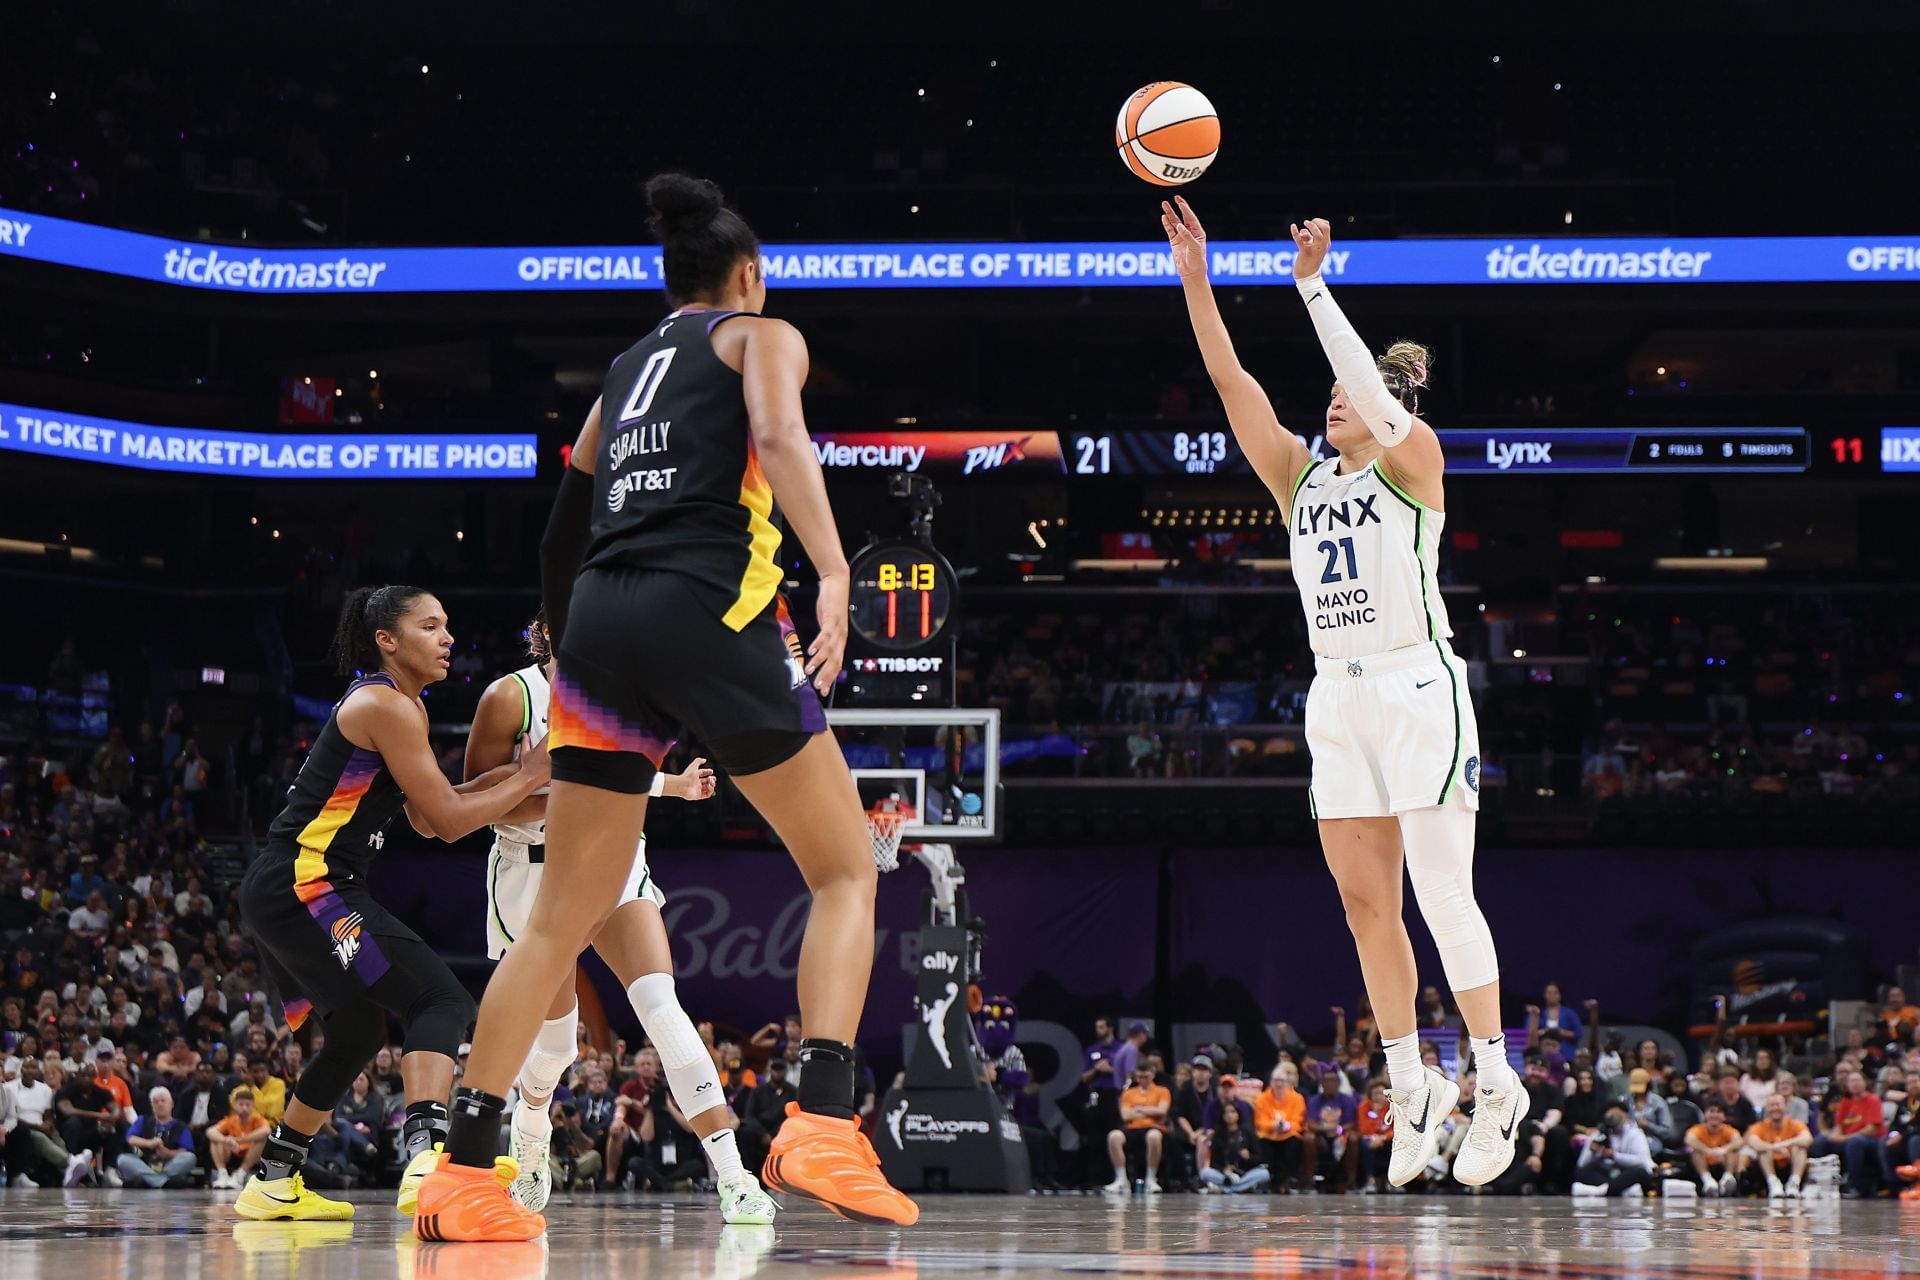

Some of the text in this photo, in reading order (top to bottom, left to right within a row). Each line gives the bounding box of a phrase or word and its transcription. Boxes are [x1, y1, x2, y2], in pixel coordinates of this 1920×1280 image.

[164, 247, 386, 288] ticketmaster
[518, 256, 649, 281] OFFICIAL
[761, 250, 1350, 279] MARKETPLACE OF THE PHOEN MERCRY
[1485, 244, 1712, 279] ticketmaster
[1847, 246, 1920, 271] OFFI
[619, 347, 677, 425] 0
[16, 416, 117, 453] TICKET
[122, 432, 333, 469] MARKETPLACE
[339, 444, 380, 469] OF
[385, 444, 440, 469] THE
[609, 421, 672, 471] SABALLY
[810, 441, 926, 472] Mercury
[1076, 436, 1111, 474] 21
[1173, 432, 1226, 462] 8:13
[1487, 438, 1552, 469] Lynx
[1650, 443, 1660, 458] 2
[1668, 444, 1704, 456] FOULS
[1740, 444, 1794, 456] TIMEOUTS
[1832, 438, 1863, 463] 11
[624, 467, 677, 493] AT&T
[1298, 494, 1381, 536] LYNX
[1317, 537, 1358, 584] 21
[879, 563, 935, 591] 8:13
[1316, 588, 1369, 610] MAYO
[887, 590, 930, 638] 11
[1315, 607, 1376, 630] CLINIC
[876, 657, 943, 672] TISSOT
[958, 815, 985, 826] AT&T
[922, 951, 959, 974] ally
[905, 1121, 990, 1134] PLAYOFFS
